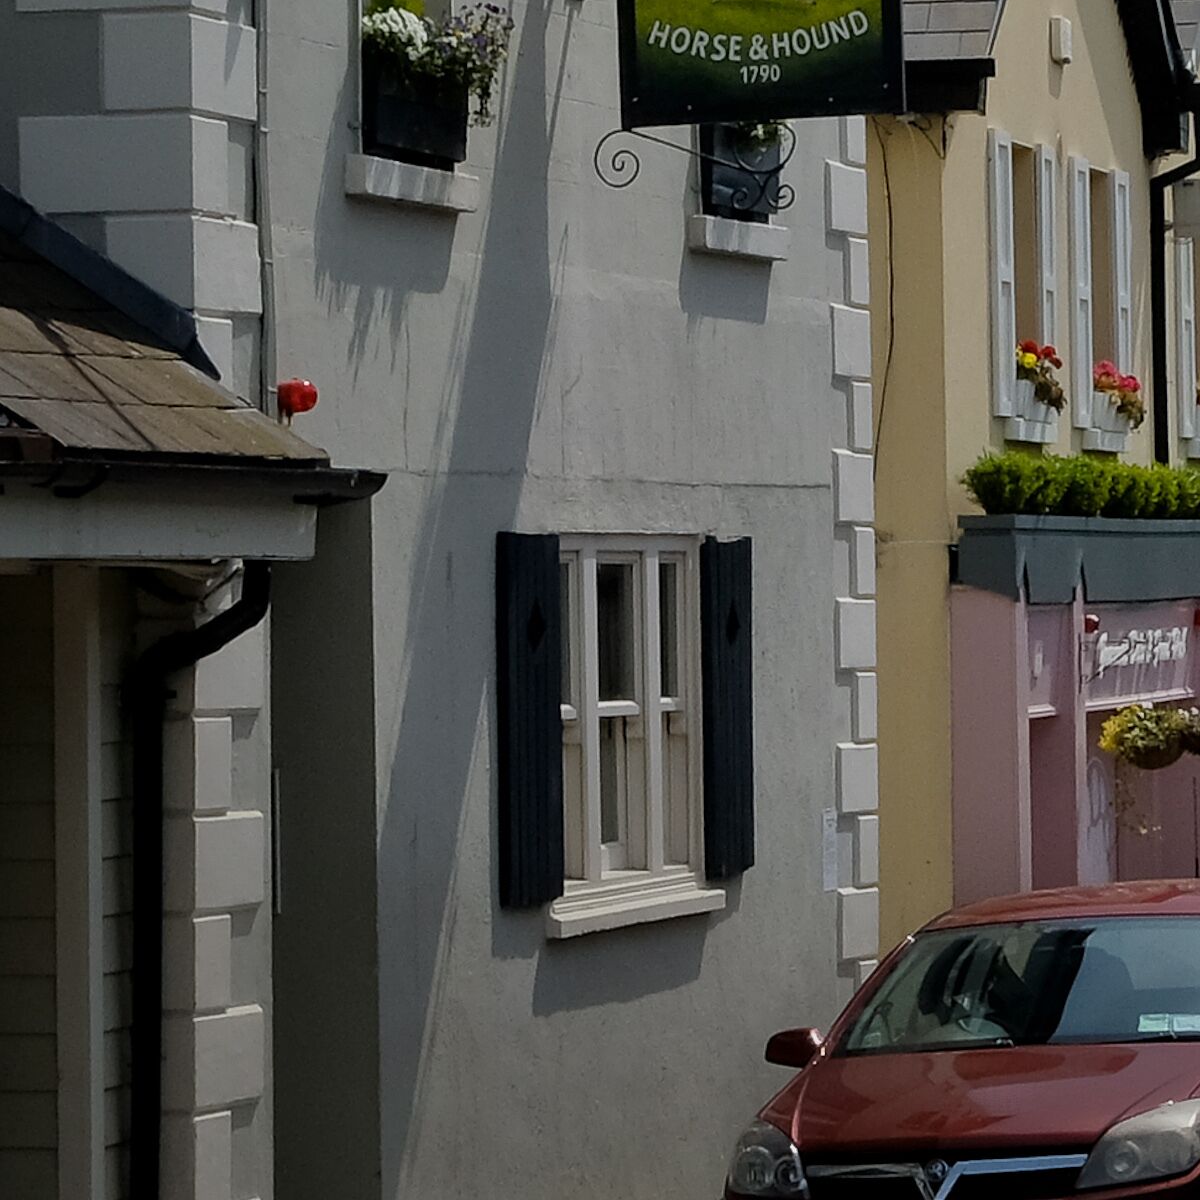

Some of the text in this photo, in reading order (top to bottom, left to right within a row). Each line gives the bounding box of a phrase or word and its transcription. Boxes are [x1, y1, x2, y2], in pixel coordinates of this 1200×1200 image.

[648, 10, 869, 62] HORSE & HOUND
[740, 64, 781, 84] 1790
